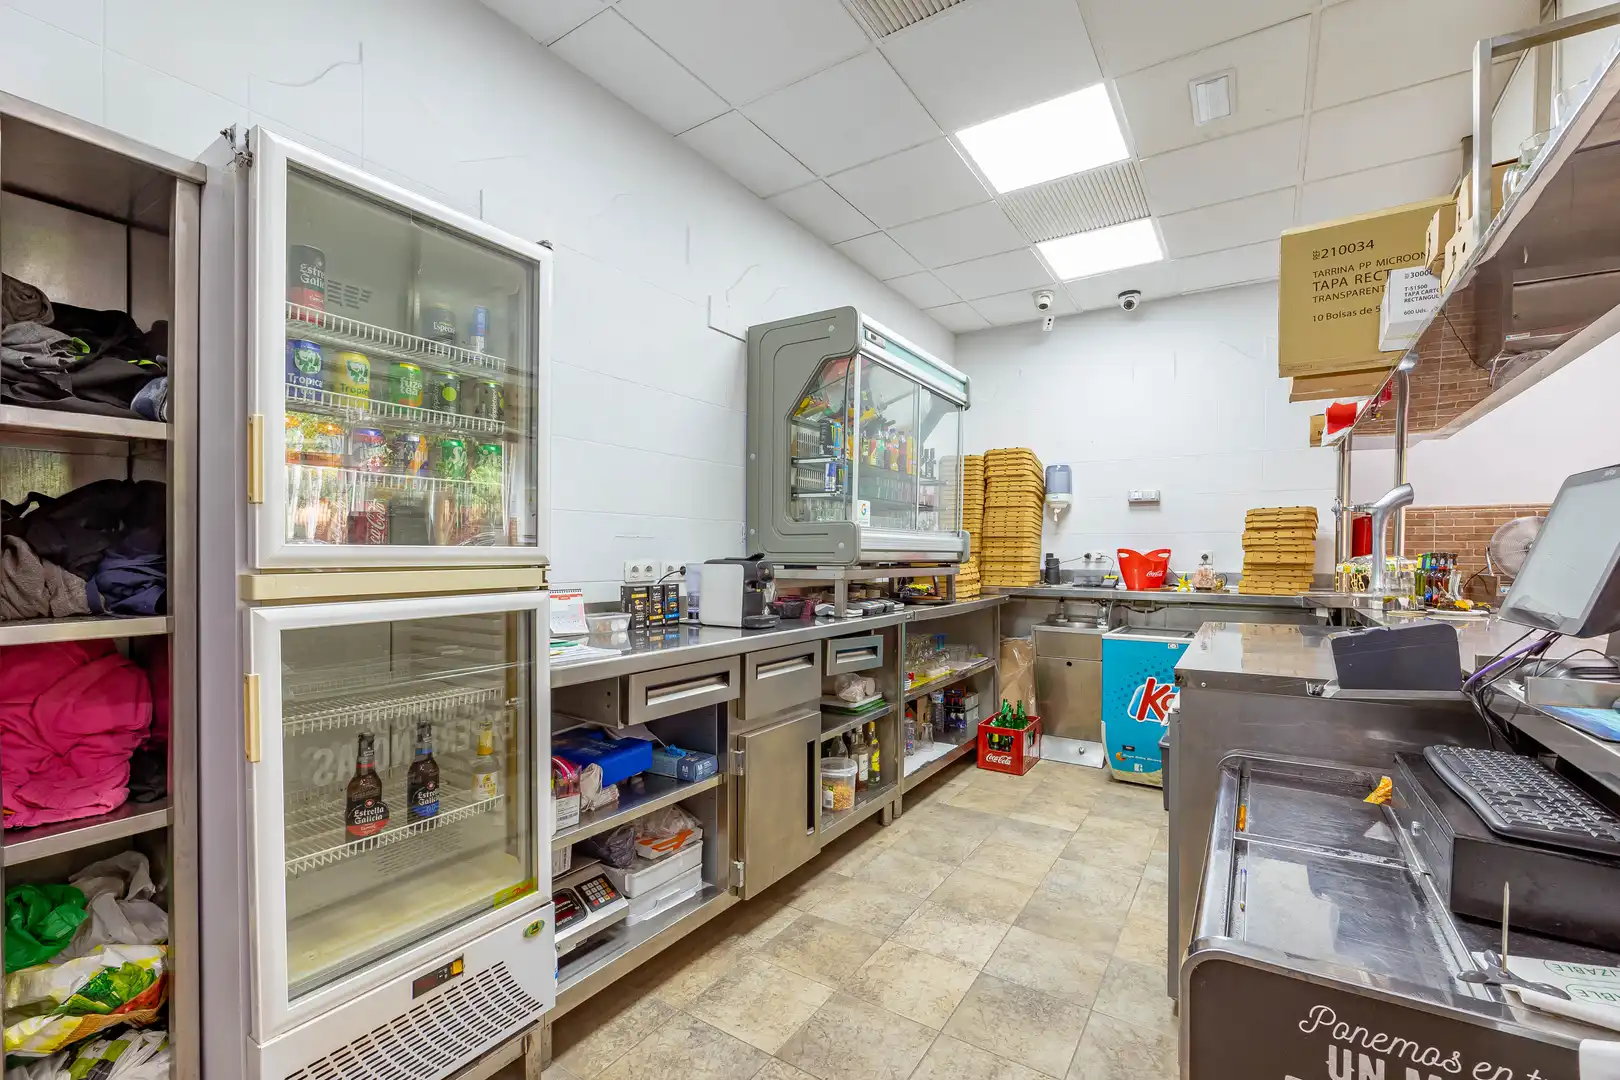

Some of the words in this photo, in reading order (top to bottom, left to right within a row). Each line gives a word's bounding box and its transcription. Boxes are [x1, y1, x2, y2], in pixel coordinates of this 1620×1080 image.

[1321, 240, 1375, 259] 210034
[1312, 264, 1355, 279] TARRINA
[1359, 261, 1372, 271] PP
[1312, 276, 1349, 292] TAPA
[1355, 268, 1393, 285] RECT
[1312, 284, 1386, 304] TRANSPARENT
[1404, 290, 1420, 298] TAPA
[1312, 314, 1324, 322] 10
[1326, 309, 1357, 321] Bolsas
[1359, 306, 1373, 316] de
[985, 753, 1012, 766] Coca-Cola
[354, 806, 385, 819] Estrella
[354, 814, 383, 825] Galicia
[1552, 962, 1620, 978] IZABLE
[1298, 1004, 1463, 1075] Ponemos
